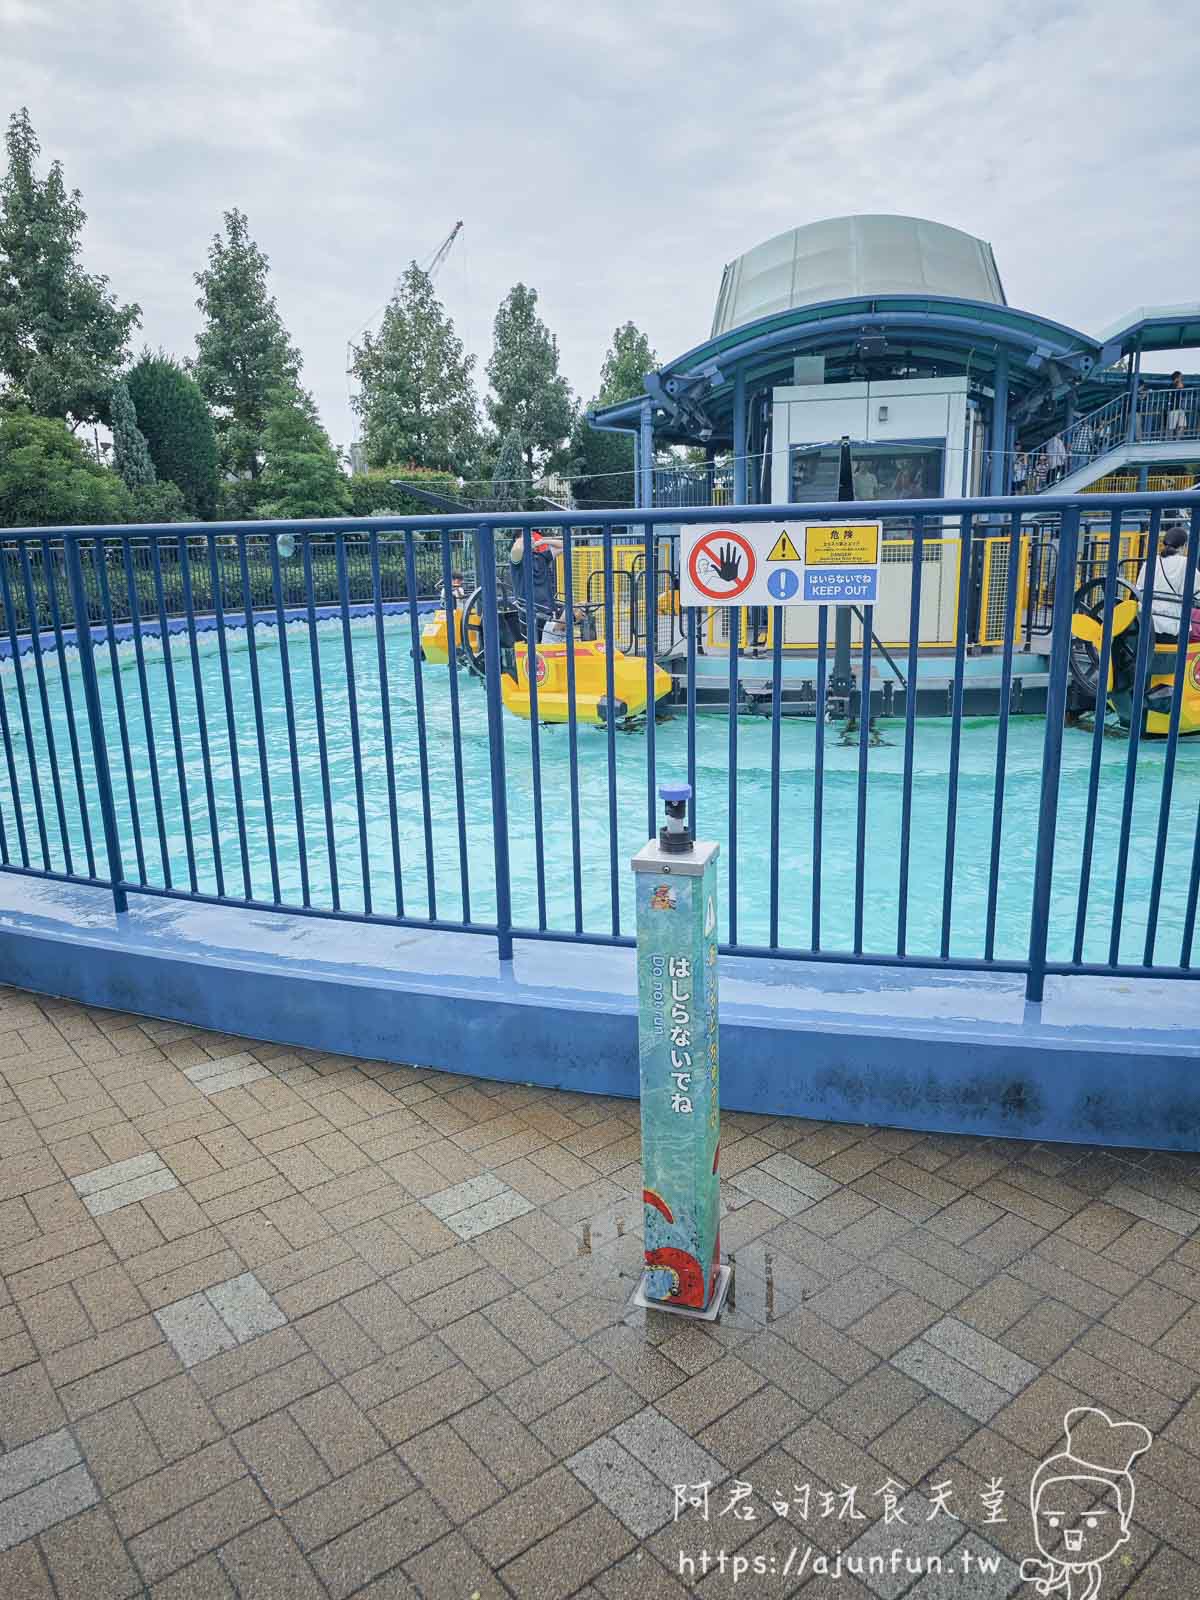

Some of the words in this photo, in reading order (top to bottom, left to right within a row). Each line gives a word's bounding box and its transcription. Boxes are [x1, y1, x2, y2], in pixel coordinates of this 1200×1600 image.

[809, 574, 872, 584] はいらないでね
[812, 585, 841, 596] KEEP
[845, 585, 868, 596] OUT
[652, 956, 665, 977] Do
[653, 982, 665, 1008] not
[653, 1011, 665, 1035] run
[668, 956, 693, 1113] はしらないでね
